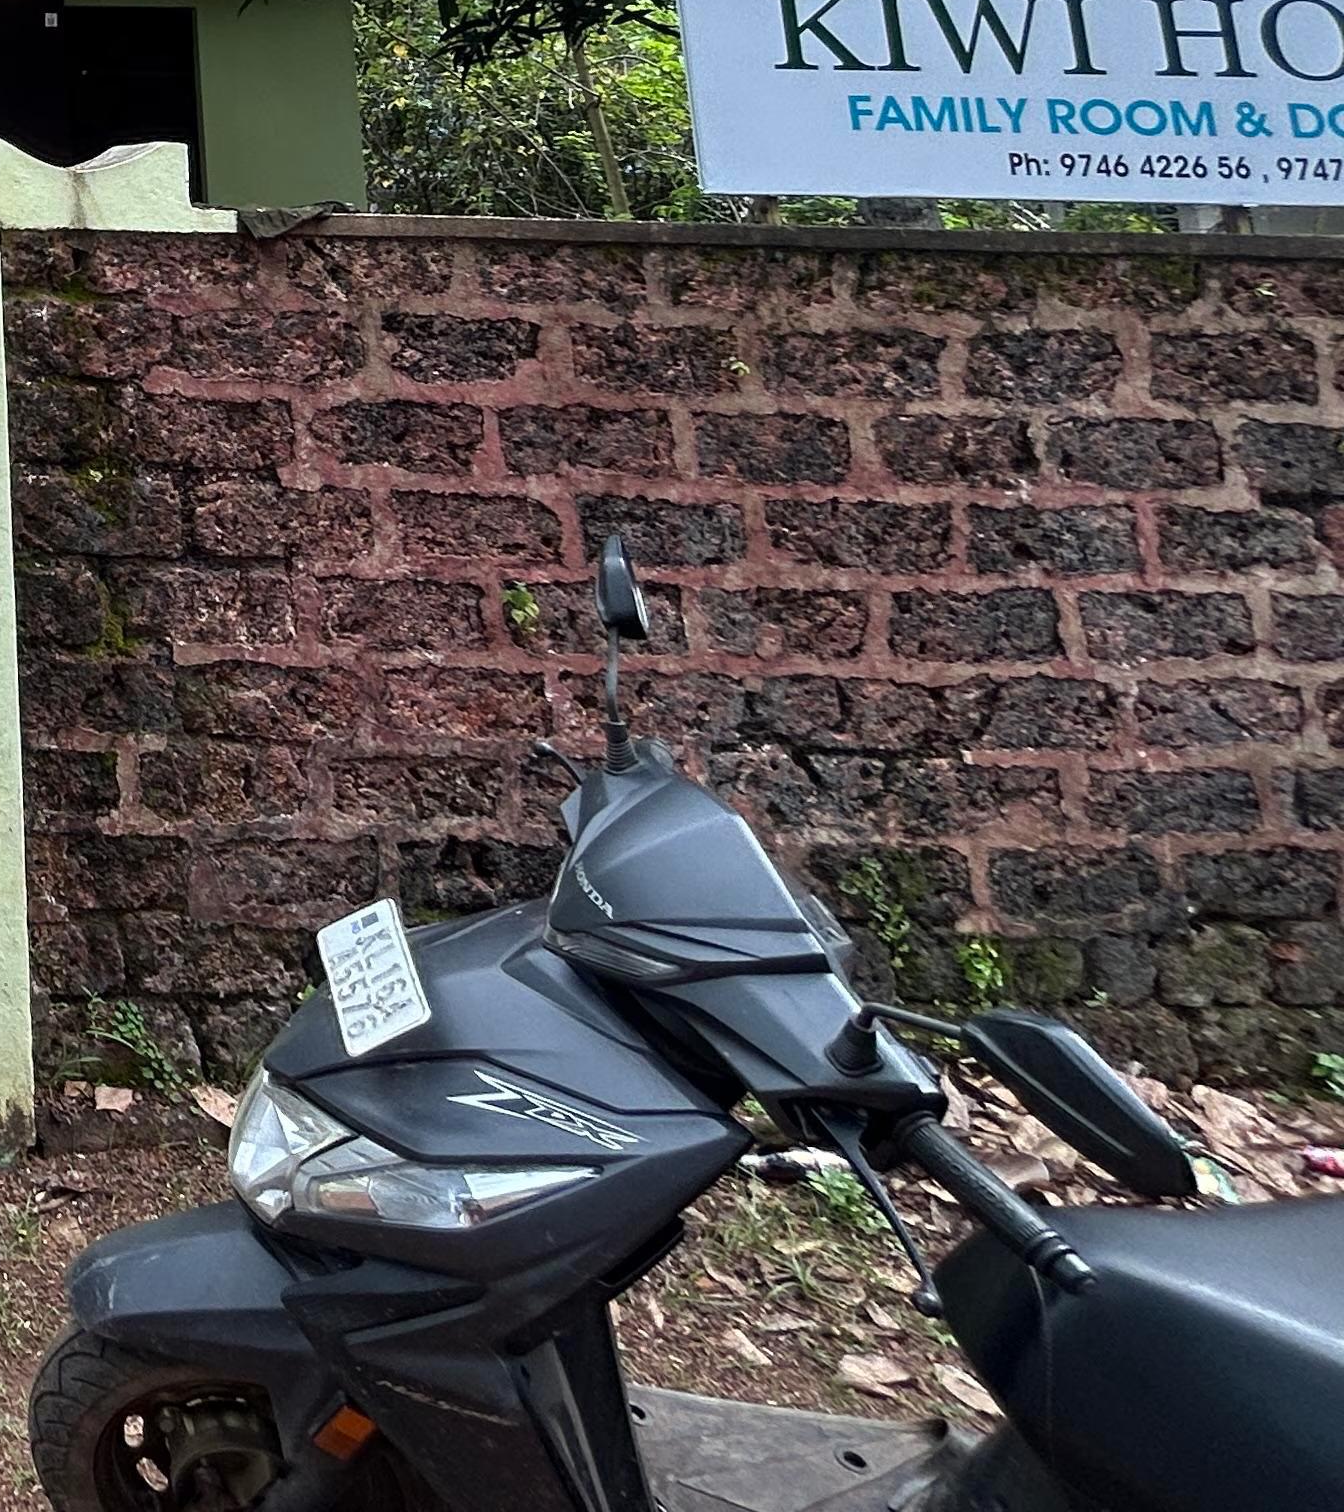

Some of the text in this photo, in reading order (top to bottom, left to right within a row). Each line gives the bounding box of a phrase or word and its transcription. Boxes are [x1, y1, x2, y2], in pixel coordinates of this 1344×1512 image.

[848, 95, 1028, 134] FAMILY
[1046, 98, 1218, 137] ROOM
[1235, 101, 1274, 138] &
[1008, 152, 1051, 176] Ph:
[1060, 153, 1130, 178] 9746
[1140, 154, 1209, 179] 4226
[1217, 156, 1251, 179] 56
[1277, 157, 1343, 182] 9747
